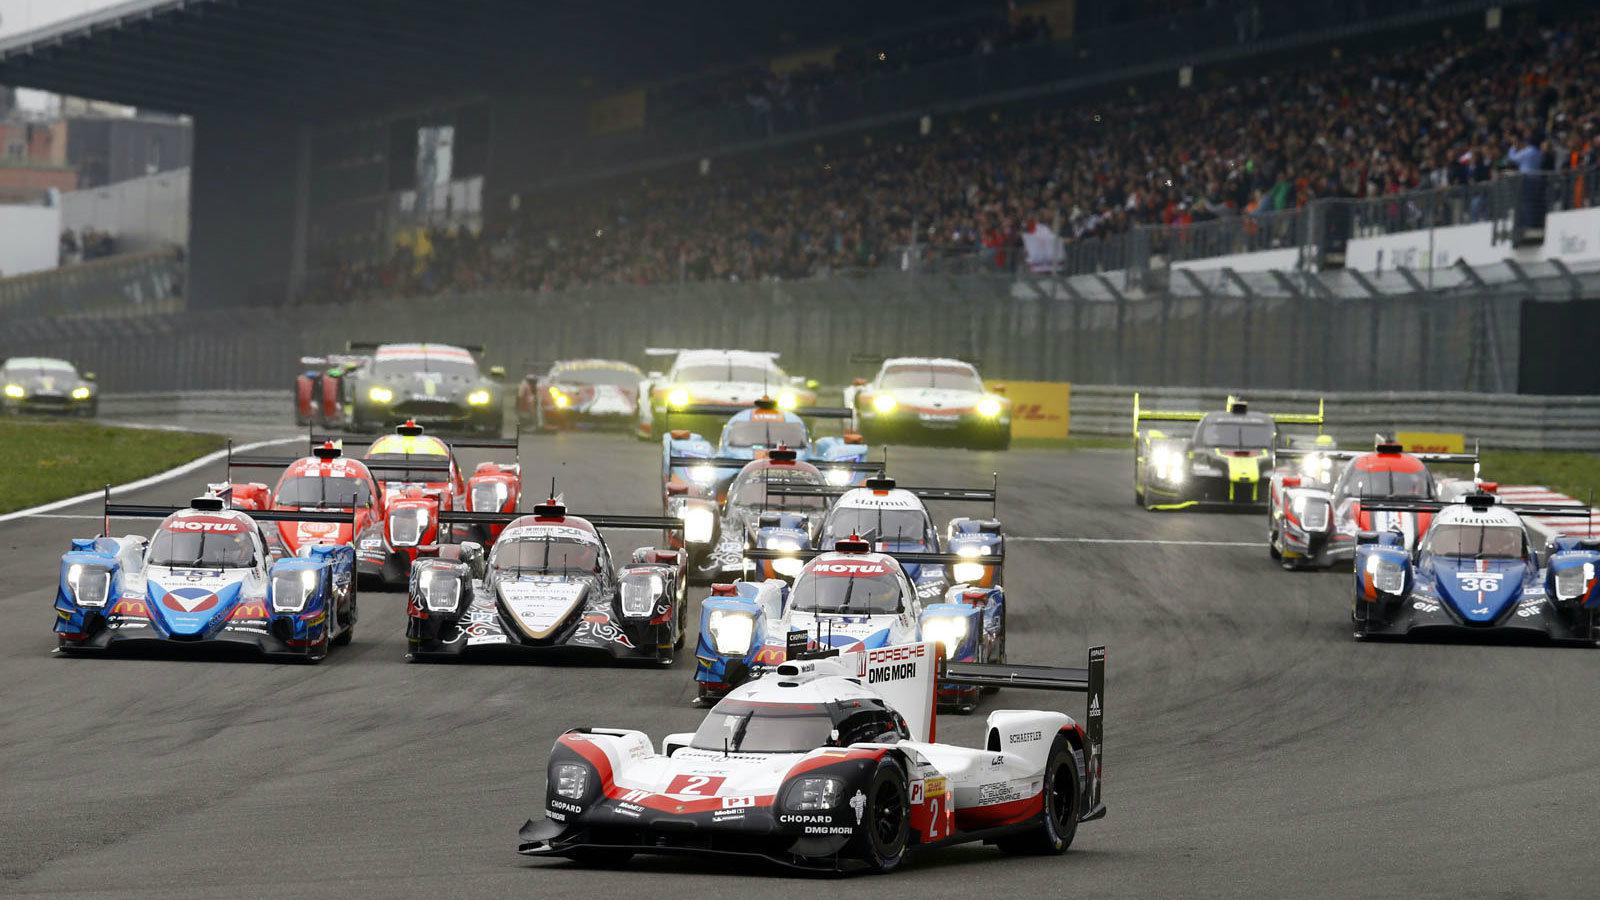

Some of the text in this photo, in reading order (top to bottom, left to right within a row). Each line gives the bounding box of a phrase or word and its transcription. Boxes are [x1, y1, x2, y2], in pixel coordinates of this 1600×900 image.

[169, 521, 240, 531] MOTUL
[812, 564, 885, 573] MOTUL
[1461, 578, 1499, 592] 36
[1413, 602, 1440, 612] elf
[1517, 605, 1541, 617] elf
[869, 645, 925, 663] PORSCHE
[868, 662, 916, 684] DMG MORI
[1009, 731, 1042, 744] SCHAEFFLER
[680, 775, 710, 795] 2
[979, 781, 1007, 790] PORSCHE
[620, 789, 652, 802] HY
[911, 783, 923, 803] P1
[978, 792, 1021, 805] PERFORMANCE
[979, 787, 1014, 798] INTELLIGENT
[551, 800, 582, 813] CHOPARD
[728, 797, 751, 806] P1
[780, 815, 832, 823] CHOPARD
[929, 799, 939, 838] 2
[805, 826, 853, 835] DMG MORI
